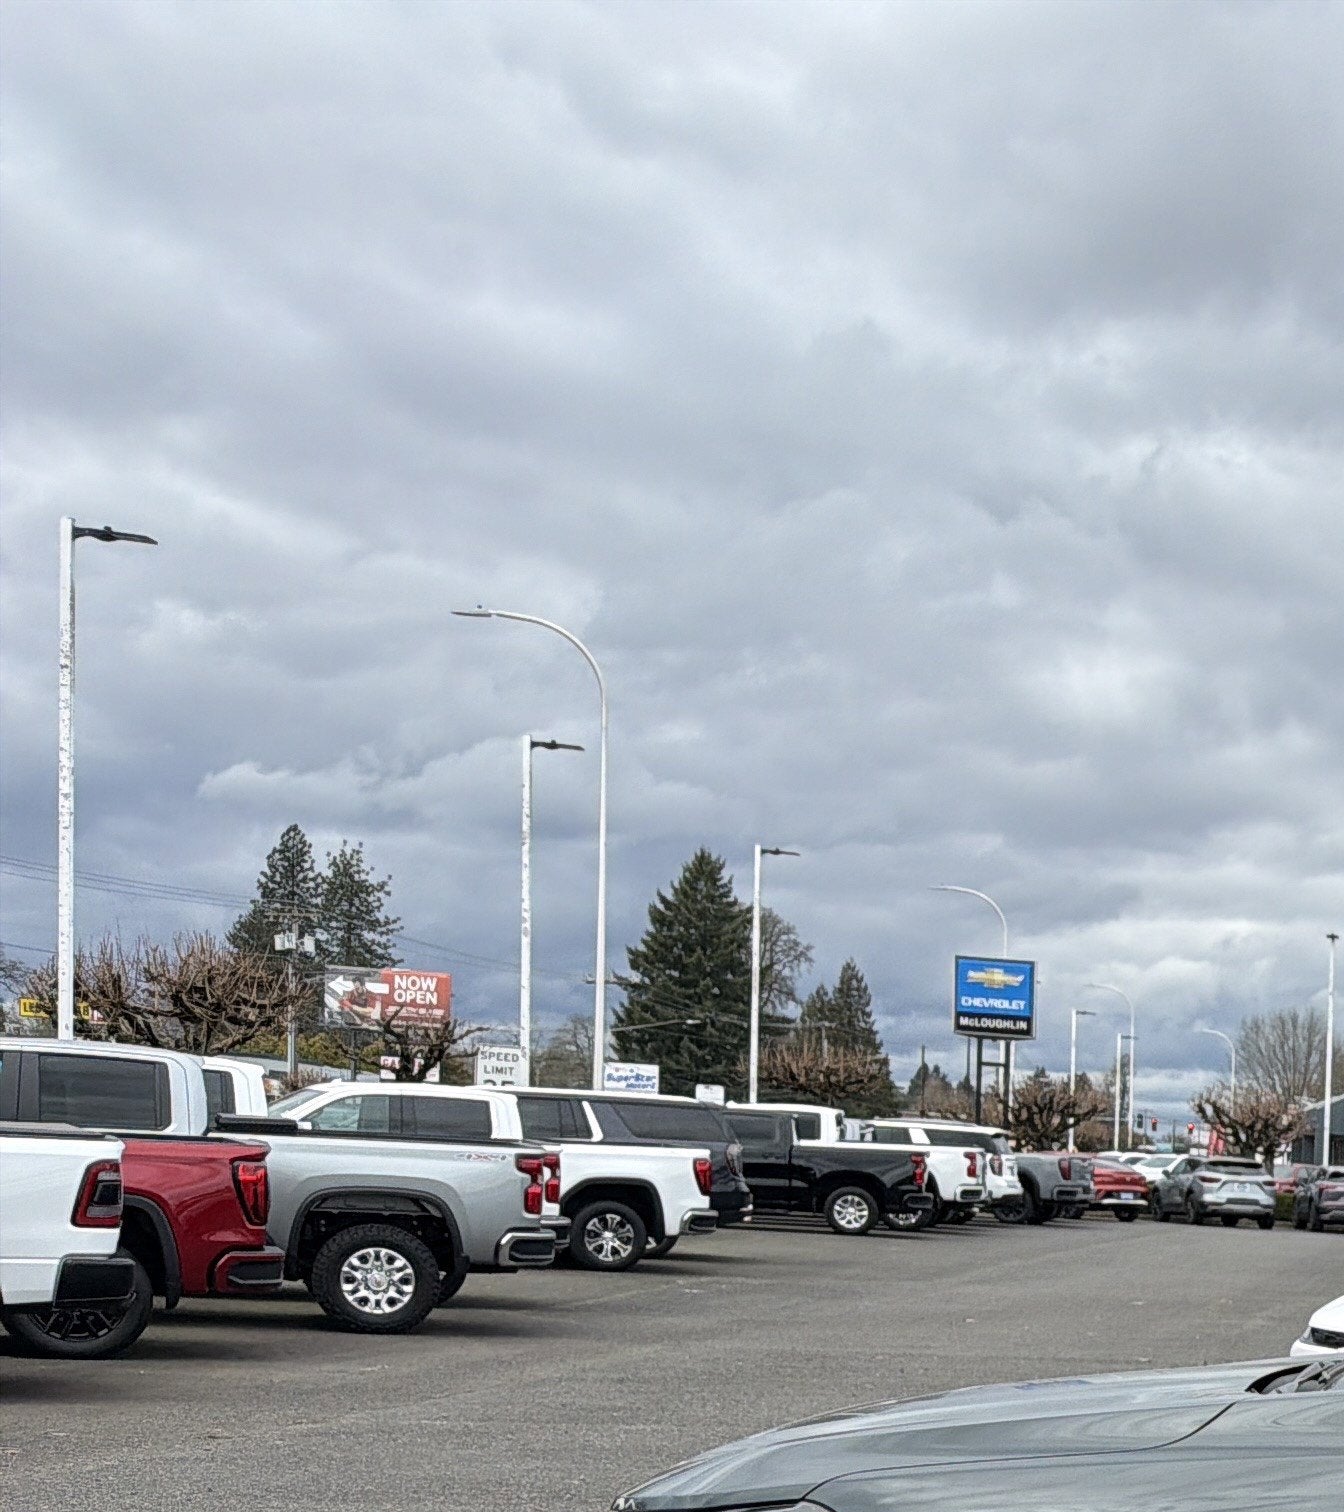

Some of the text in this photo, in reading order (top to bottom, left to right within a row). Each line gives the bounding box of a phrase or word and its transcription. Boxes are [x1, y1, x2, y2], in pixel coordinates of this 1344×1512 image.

[394, 975, 438, 992] NOW
[393, 990, 438, 1005] OPEN
[961, 996, 1026, 1010] CHEVROLET
[960, 1016, 1028, 1030] McLOUGHLIN
[480, 1050, 519, 1063] SPEED
[483, 1064, 515, 1076] LIMIT
